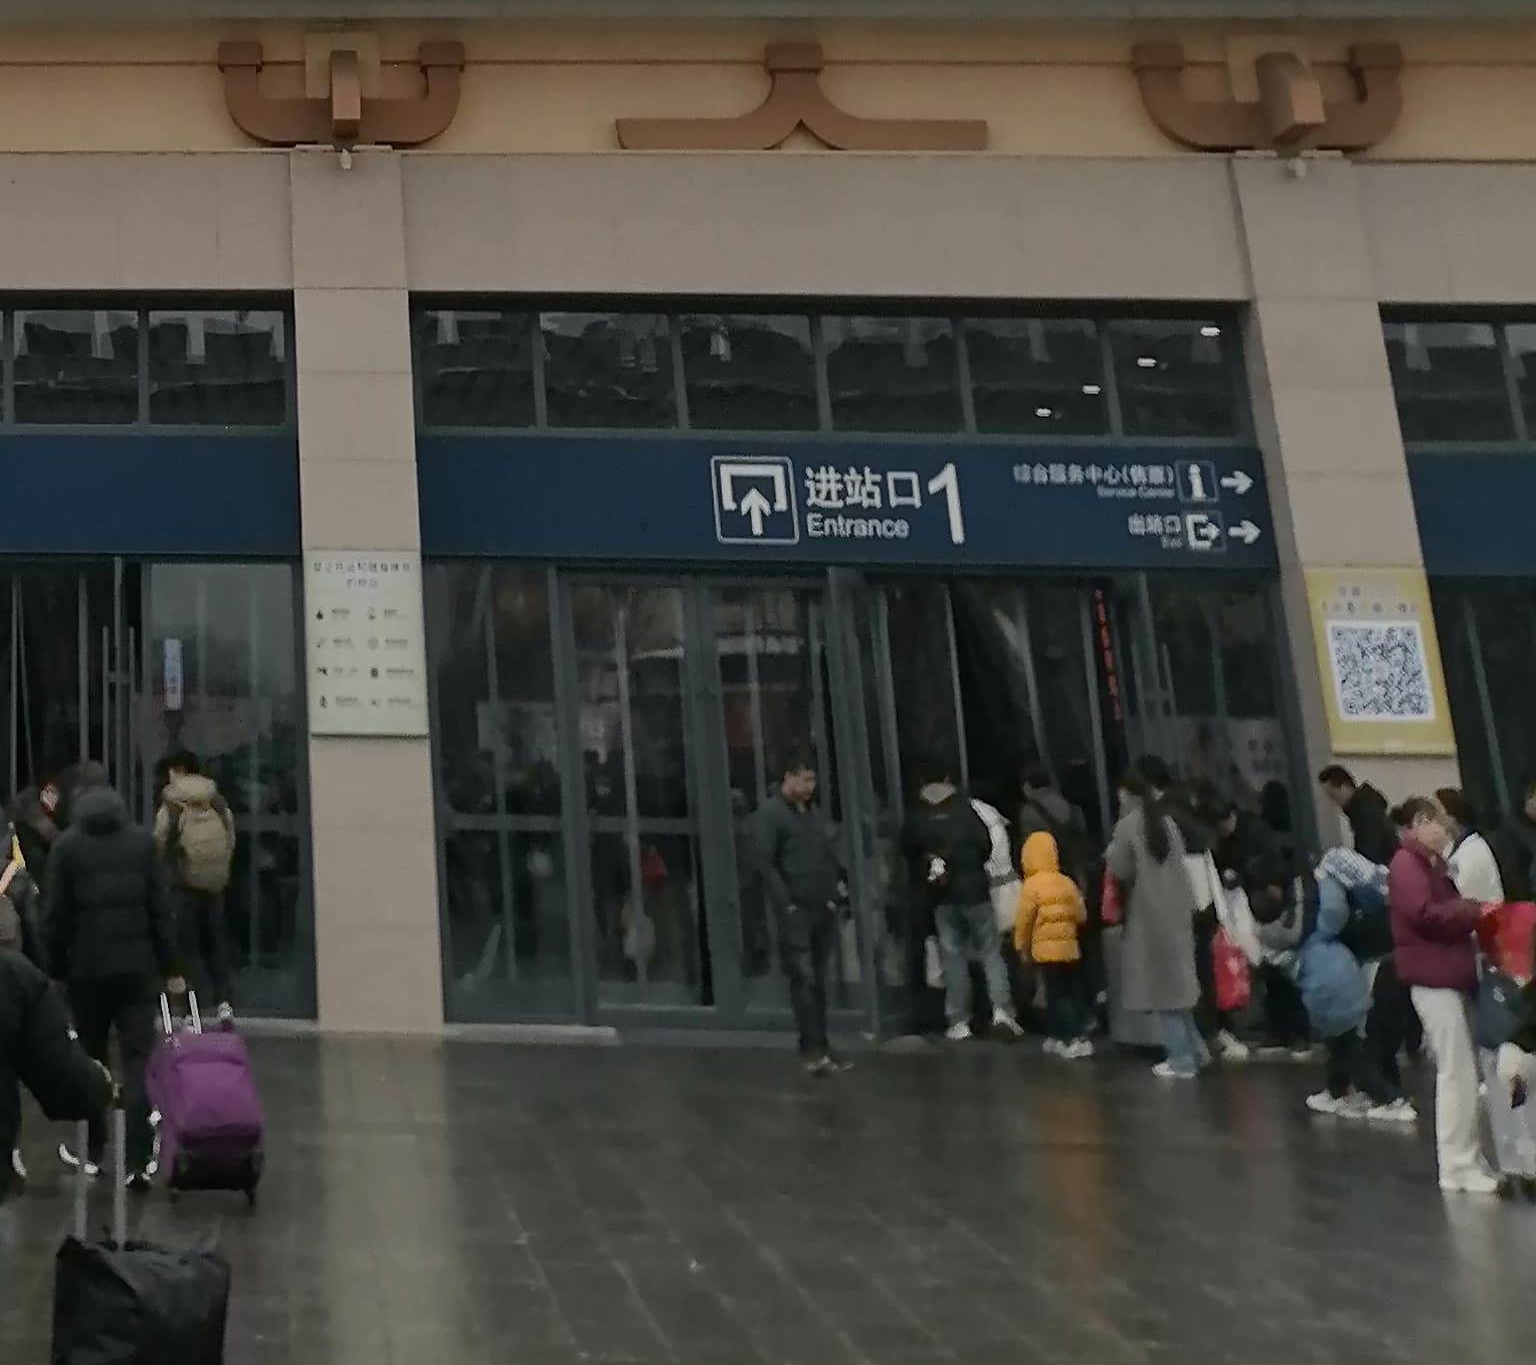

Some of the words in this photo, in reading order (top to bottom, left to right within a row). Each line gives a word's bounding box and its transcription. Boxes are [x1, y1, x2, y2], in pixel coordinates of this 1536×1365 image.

[805, 466, 922, 509] 进站口
[928, 463, 965, 544] 1
[806, 511, 911, 538] Entrance
